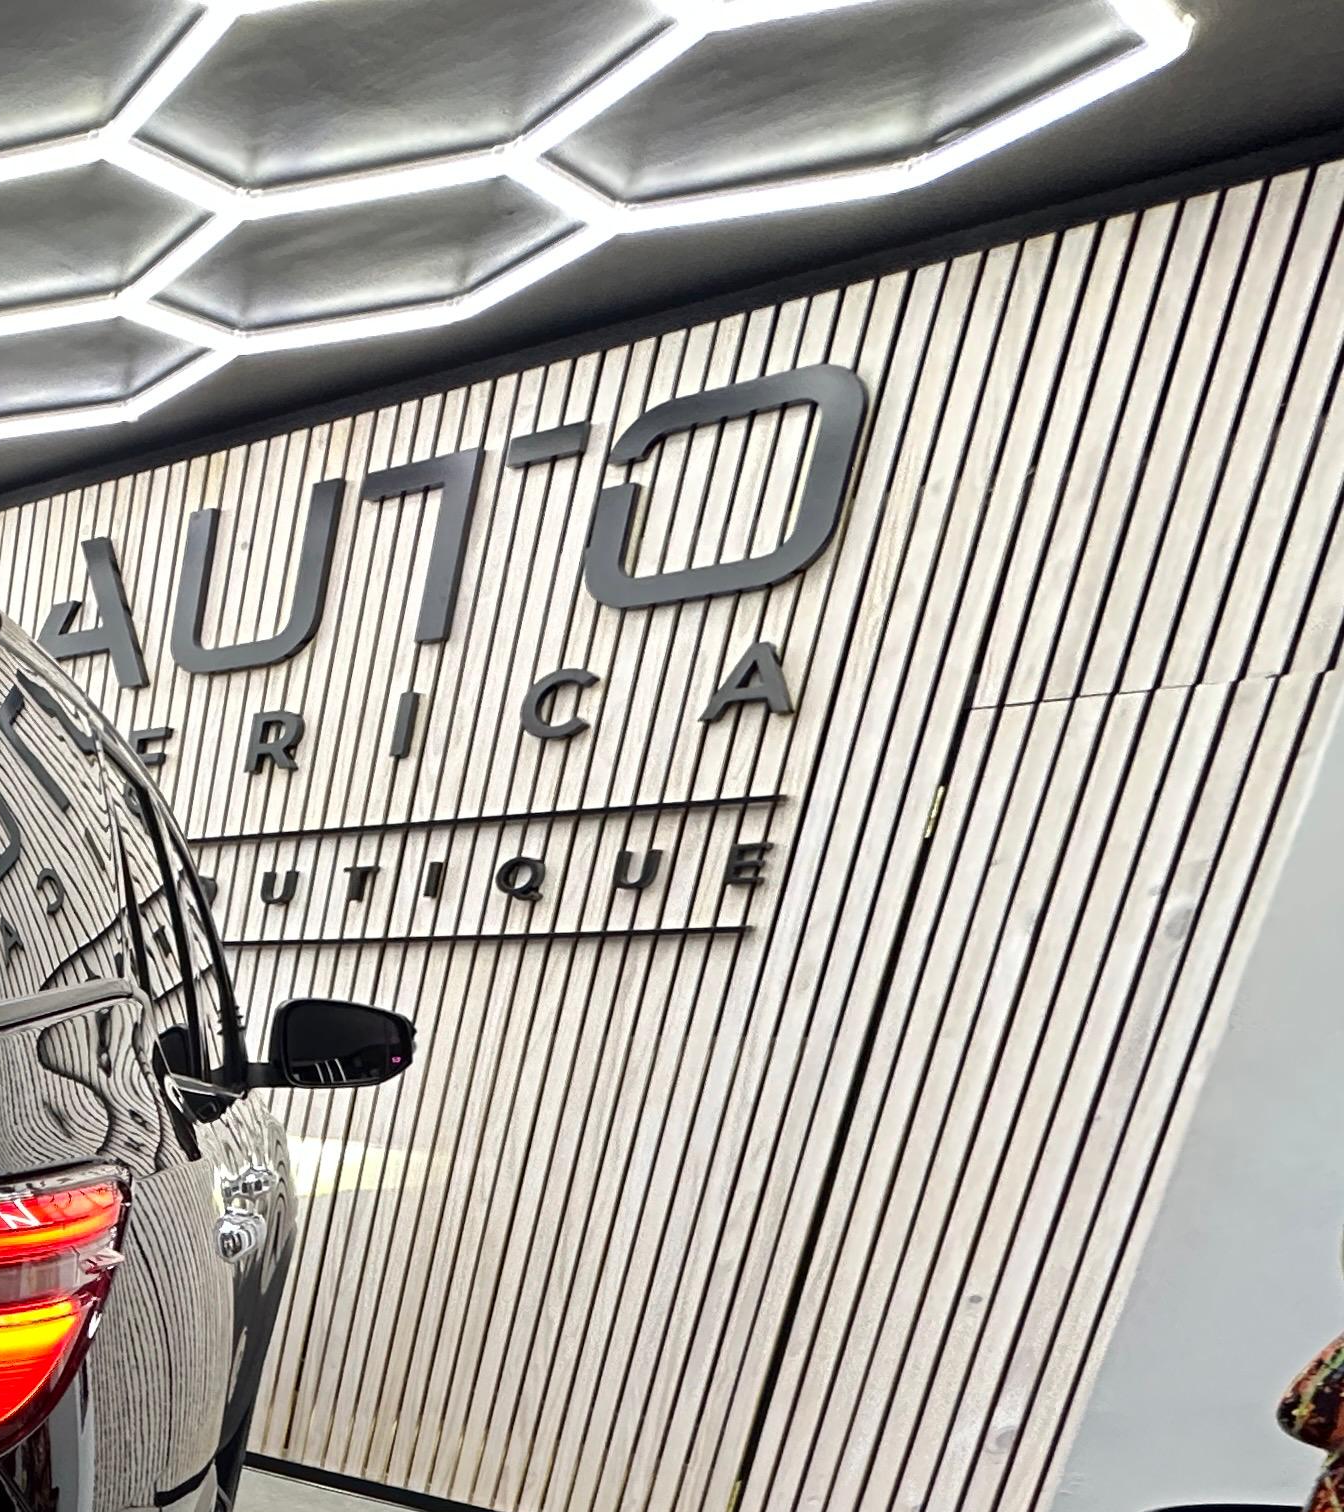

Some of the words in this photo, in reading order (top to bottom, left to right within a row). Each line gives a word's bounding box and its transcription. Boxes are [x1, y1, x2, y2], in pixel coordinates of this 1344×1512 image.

[37, 363, 870, 688] AUTO
[127, 641, 794, 776] FRICA
[200, 841, 775, 906] UTIQUE
